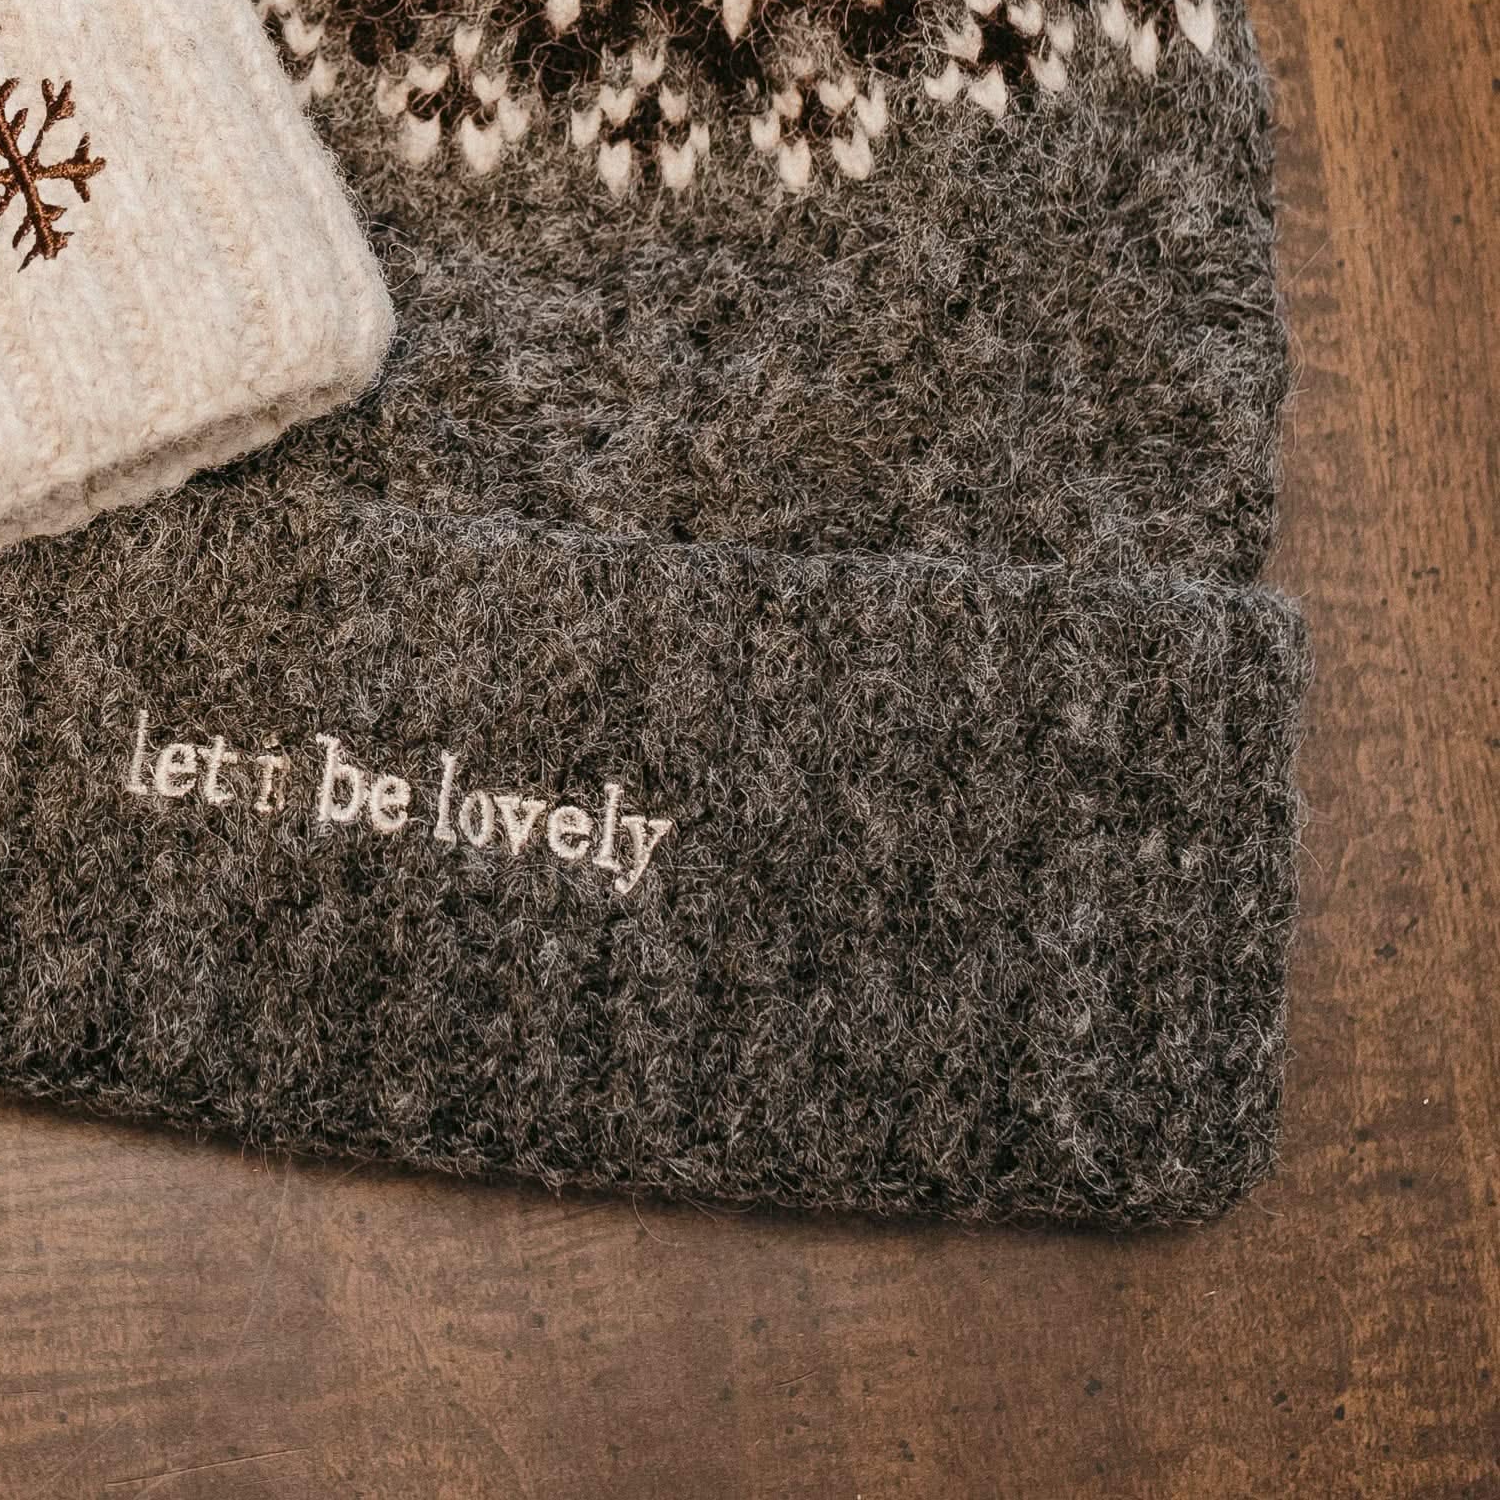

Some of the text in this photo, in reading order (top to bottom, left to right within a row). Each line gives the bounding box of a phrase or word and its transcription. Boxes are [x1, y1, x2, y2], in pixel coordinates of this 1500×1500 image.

[125, 709, 238, 804] let
[316, 732, 412, 833] be
[432, 750, 674, 894] lovely
